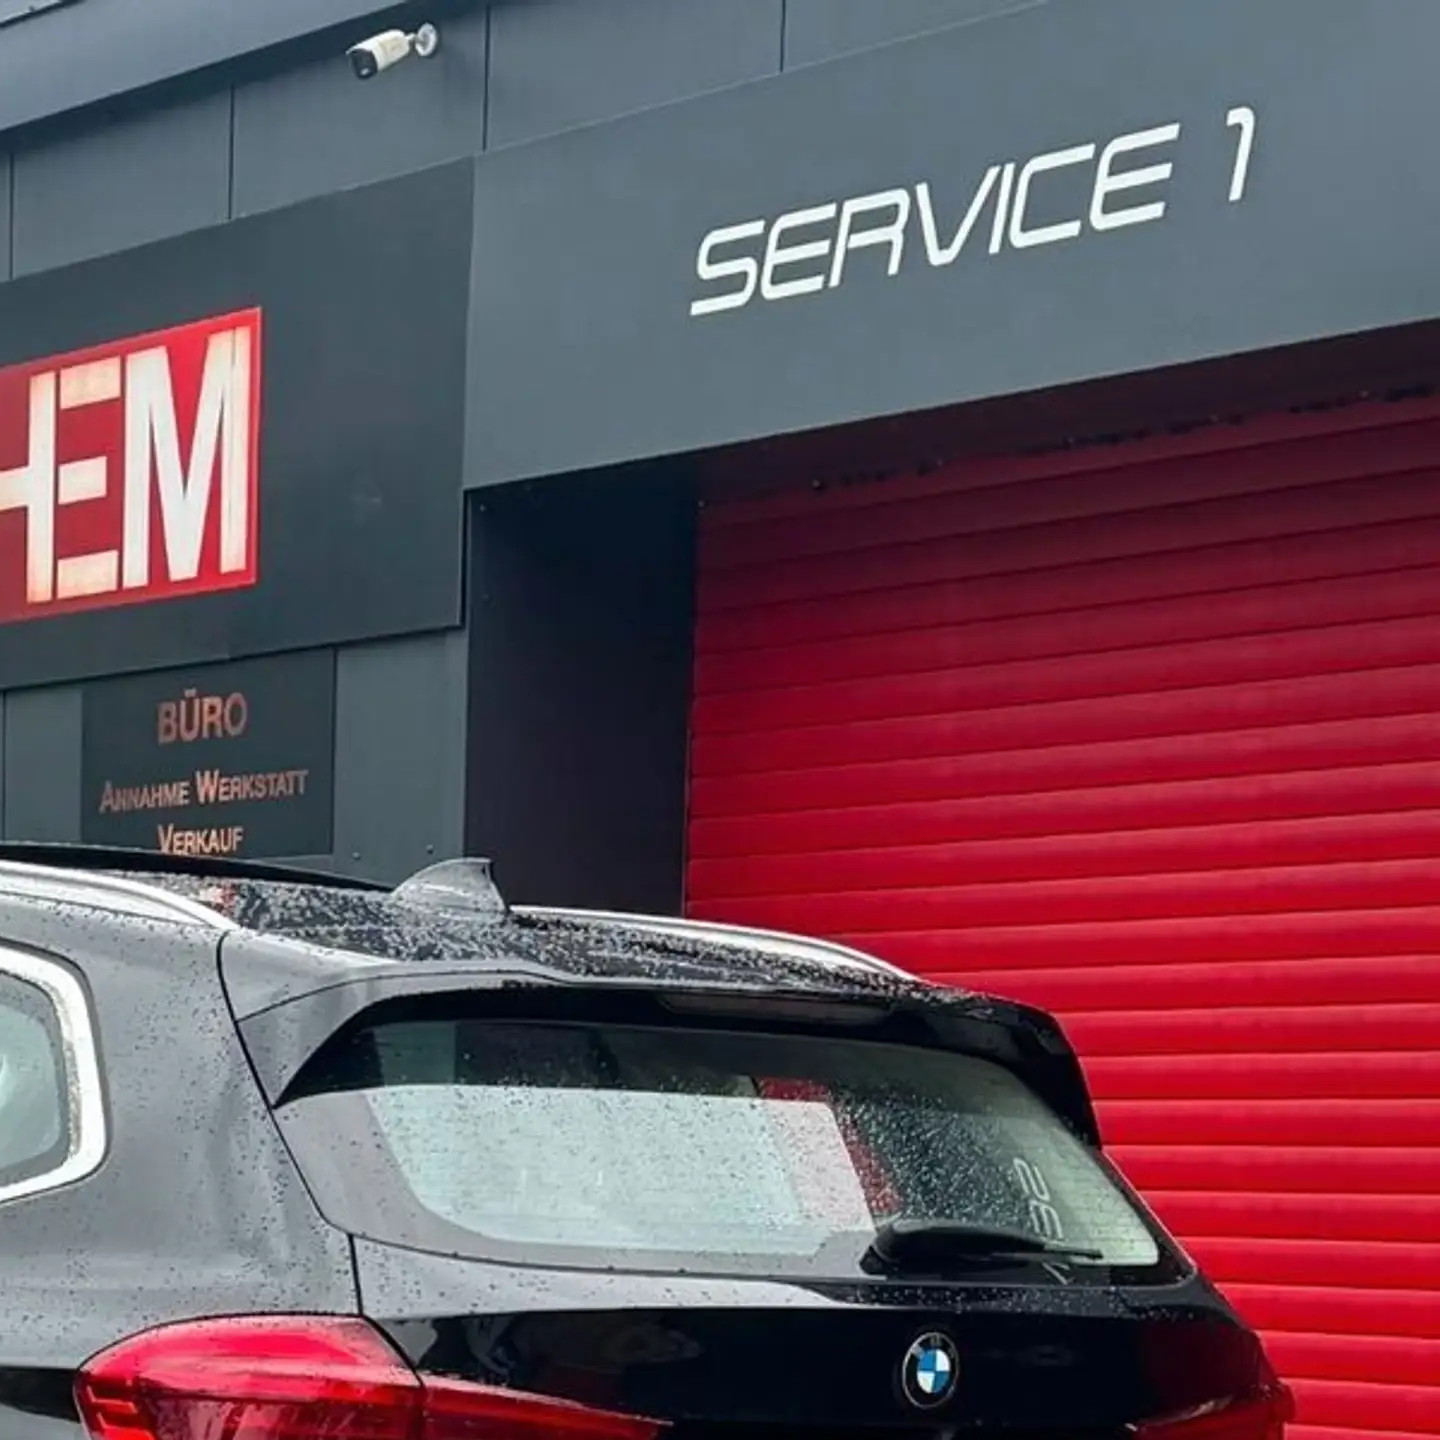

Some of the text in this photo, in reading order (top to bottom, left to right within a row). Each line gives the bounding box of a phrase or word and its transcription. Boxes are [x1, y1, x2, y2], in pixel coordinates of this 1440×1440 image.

[691, 106, 1255, 316] SERVICE 1
[158, 688, 248, 743] BÜRO
[99, 769, 309, 813] ANNAHME WERKSTATT
[158, 823, 244, 856] VERKAUF
